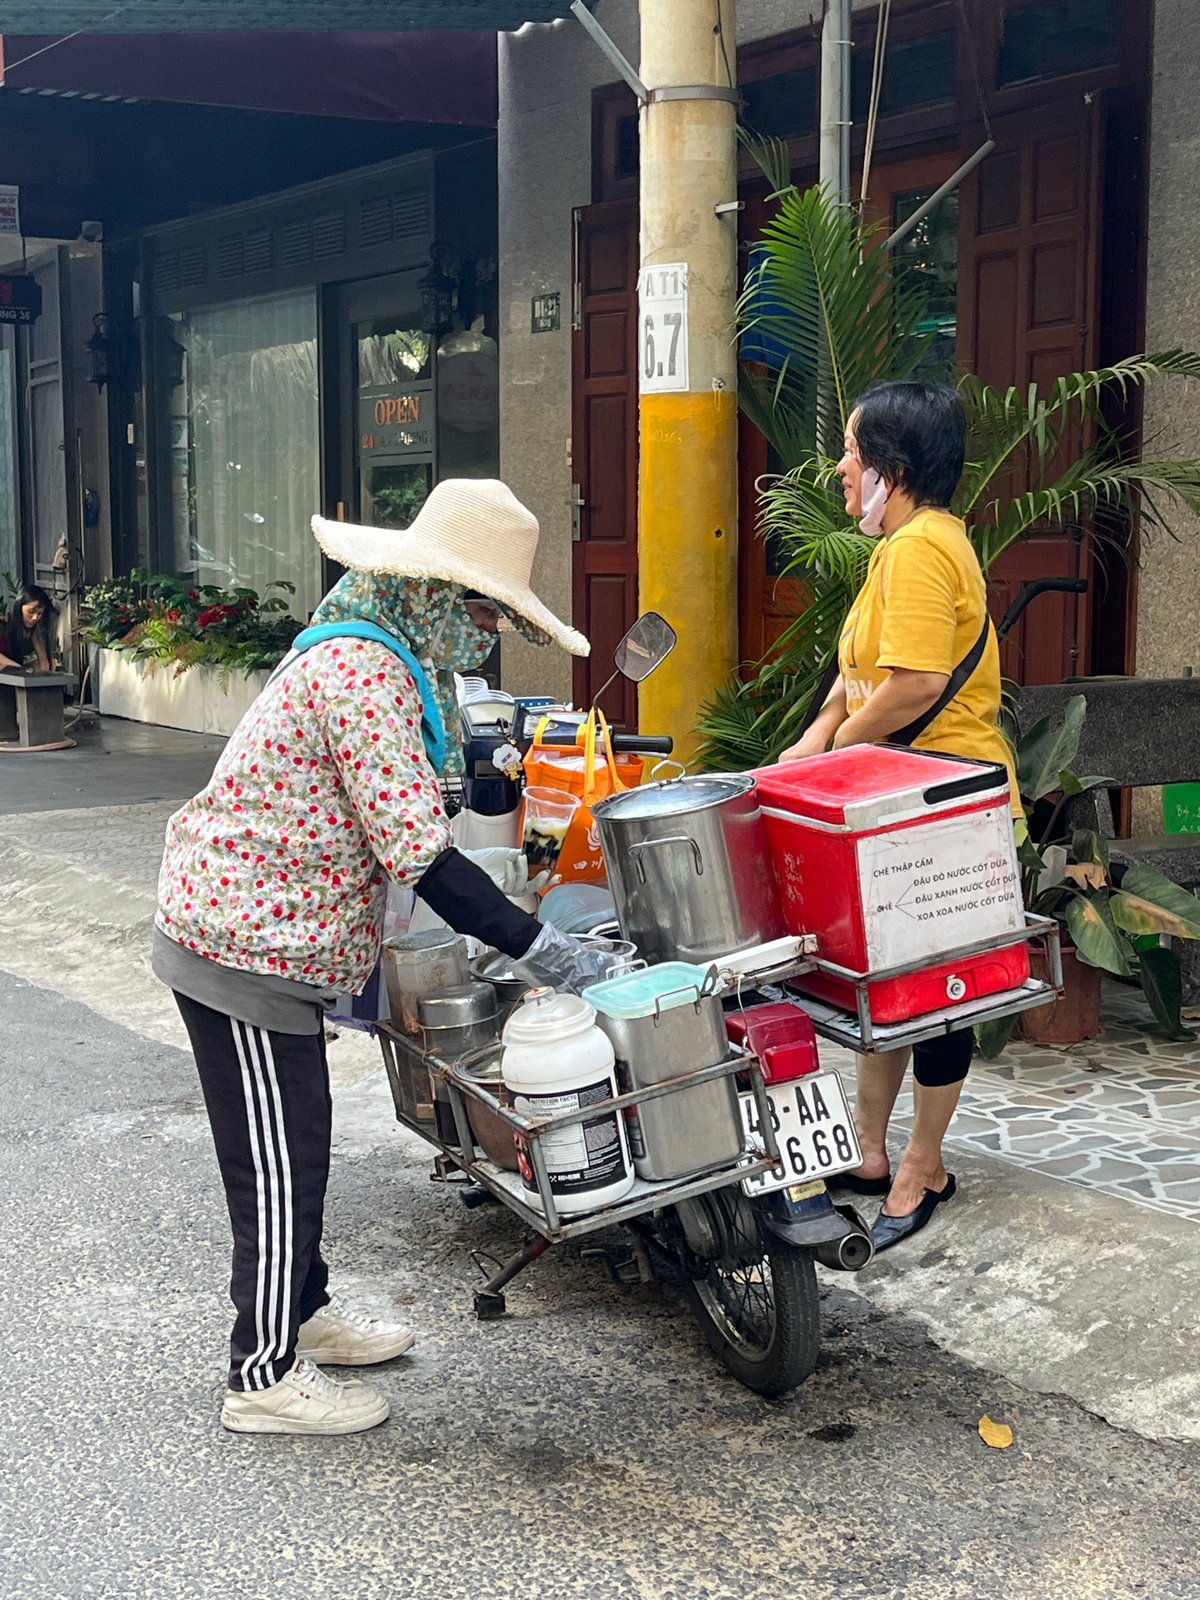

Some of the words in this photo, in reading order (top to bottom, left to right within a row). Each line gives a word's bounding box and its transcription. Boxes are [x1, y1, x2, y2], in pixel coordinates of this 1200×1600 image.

[644, 312, 682, 379] 6.7
[374, 396, 420, 426] OPEN
[873, 865, 889, 878] CHÈ
[891, 862, 913, 874] THẬP
[913, 875, 931, 887] ĐẬU
[947, 866, 971, 879] NƯỚC
[973, 863, 988, 873] CỐT
[990, 858, 1008, 870] DỪA
[915, 892, 933, 904] ĐẬU
[934, 888, 958, 899] XANH
[960, 881, 983, 894] NƯỚC
[917, 909, 935, 922] XOA
[936, 906, 953, 917] XOA
[955, 900, 979, 913] NƯỚC
[980, 896, 996, 907] CỐT
[998, 891, 1015, 903] DỪA
[560, 1094, 578, 1102] FACTS
[749, 1124, 853, 1187] 6.68
